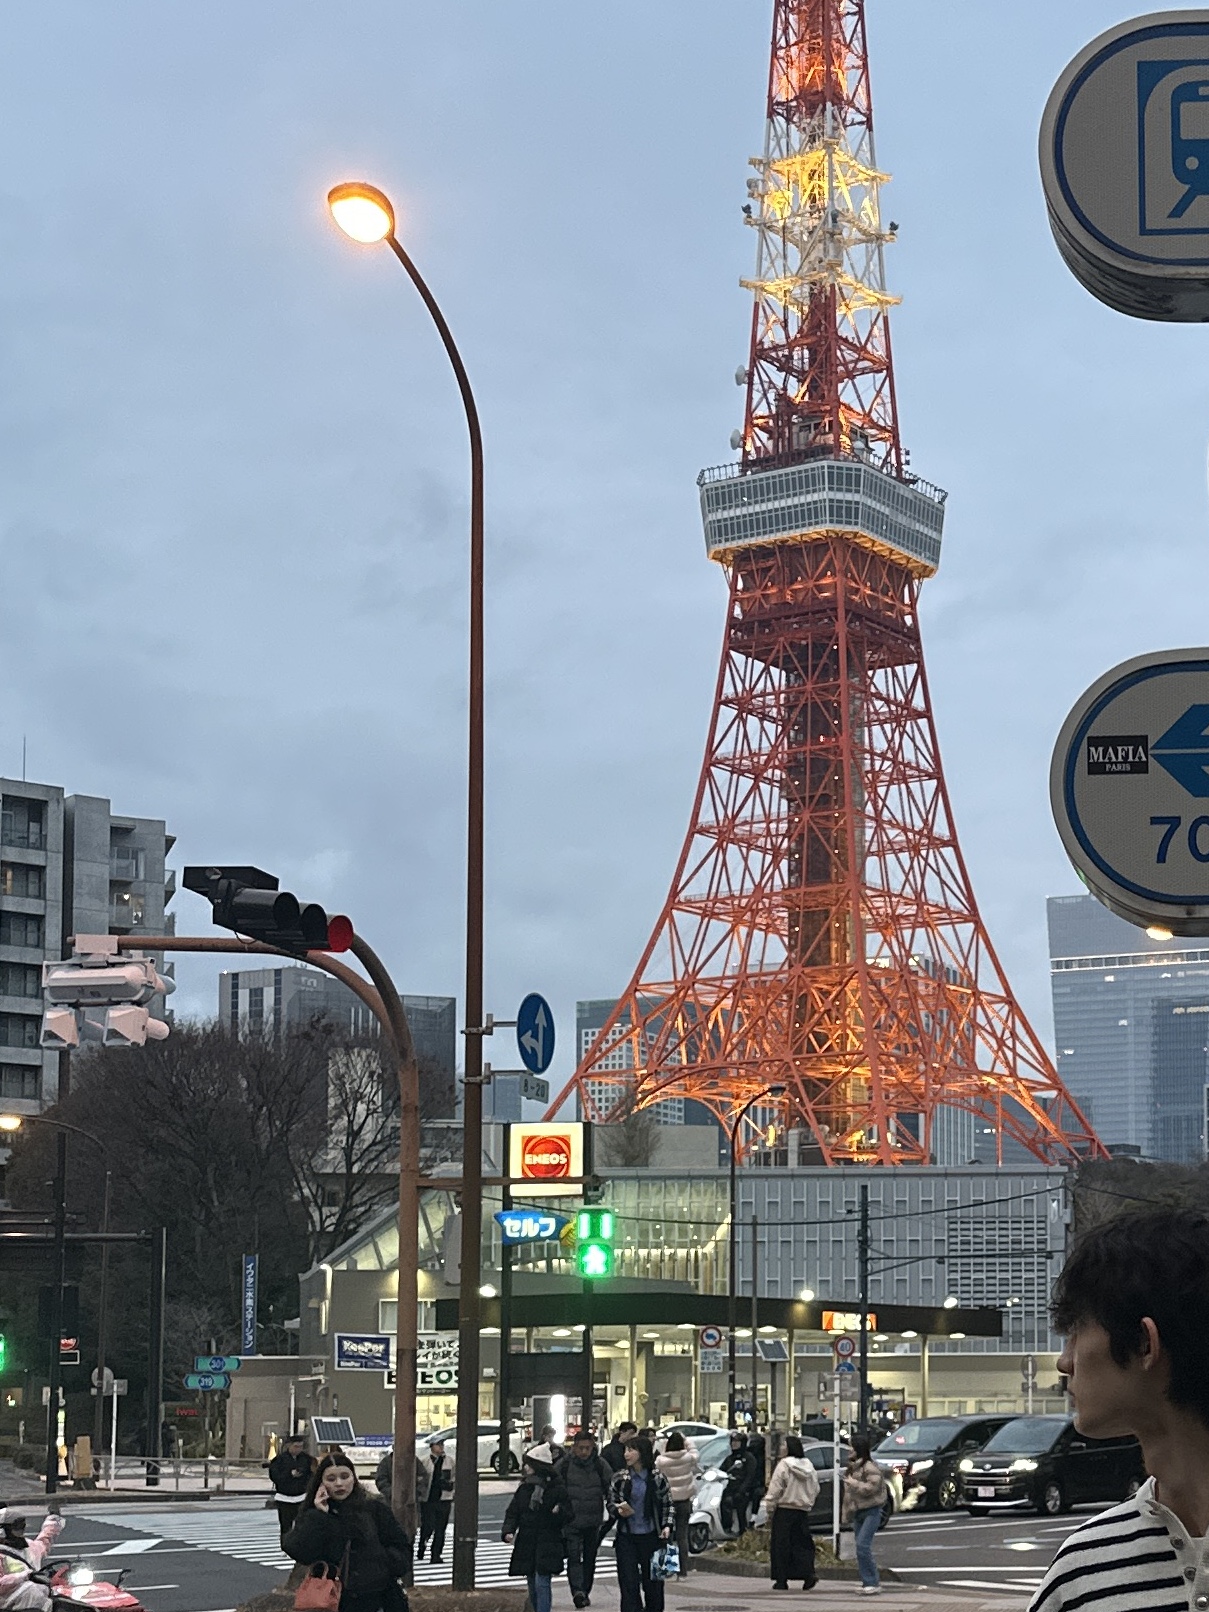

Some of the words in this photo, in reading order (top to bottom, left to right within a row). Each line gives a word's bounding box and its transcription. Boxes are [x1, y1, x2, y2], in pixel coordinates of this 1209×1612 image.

[1088, 745, 1147, 763] MAFIA
[1105, 763, 1131, 772] PARIS
[524, 1152, 568, 1165] ENEOS
[503, 1217, 556, 1238] セルフ
